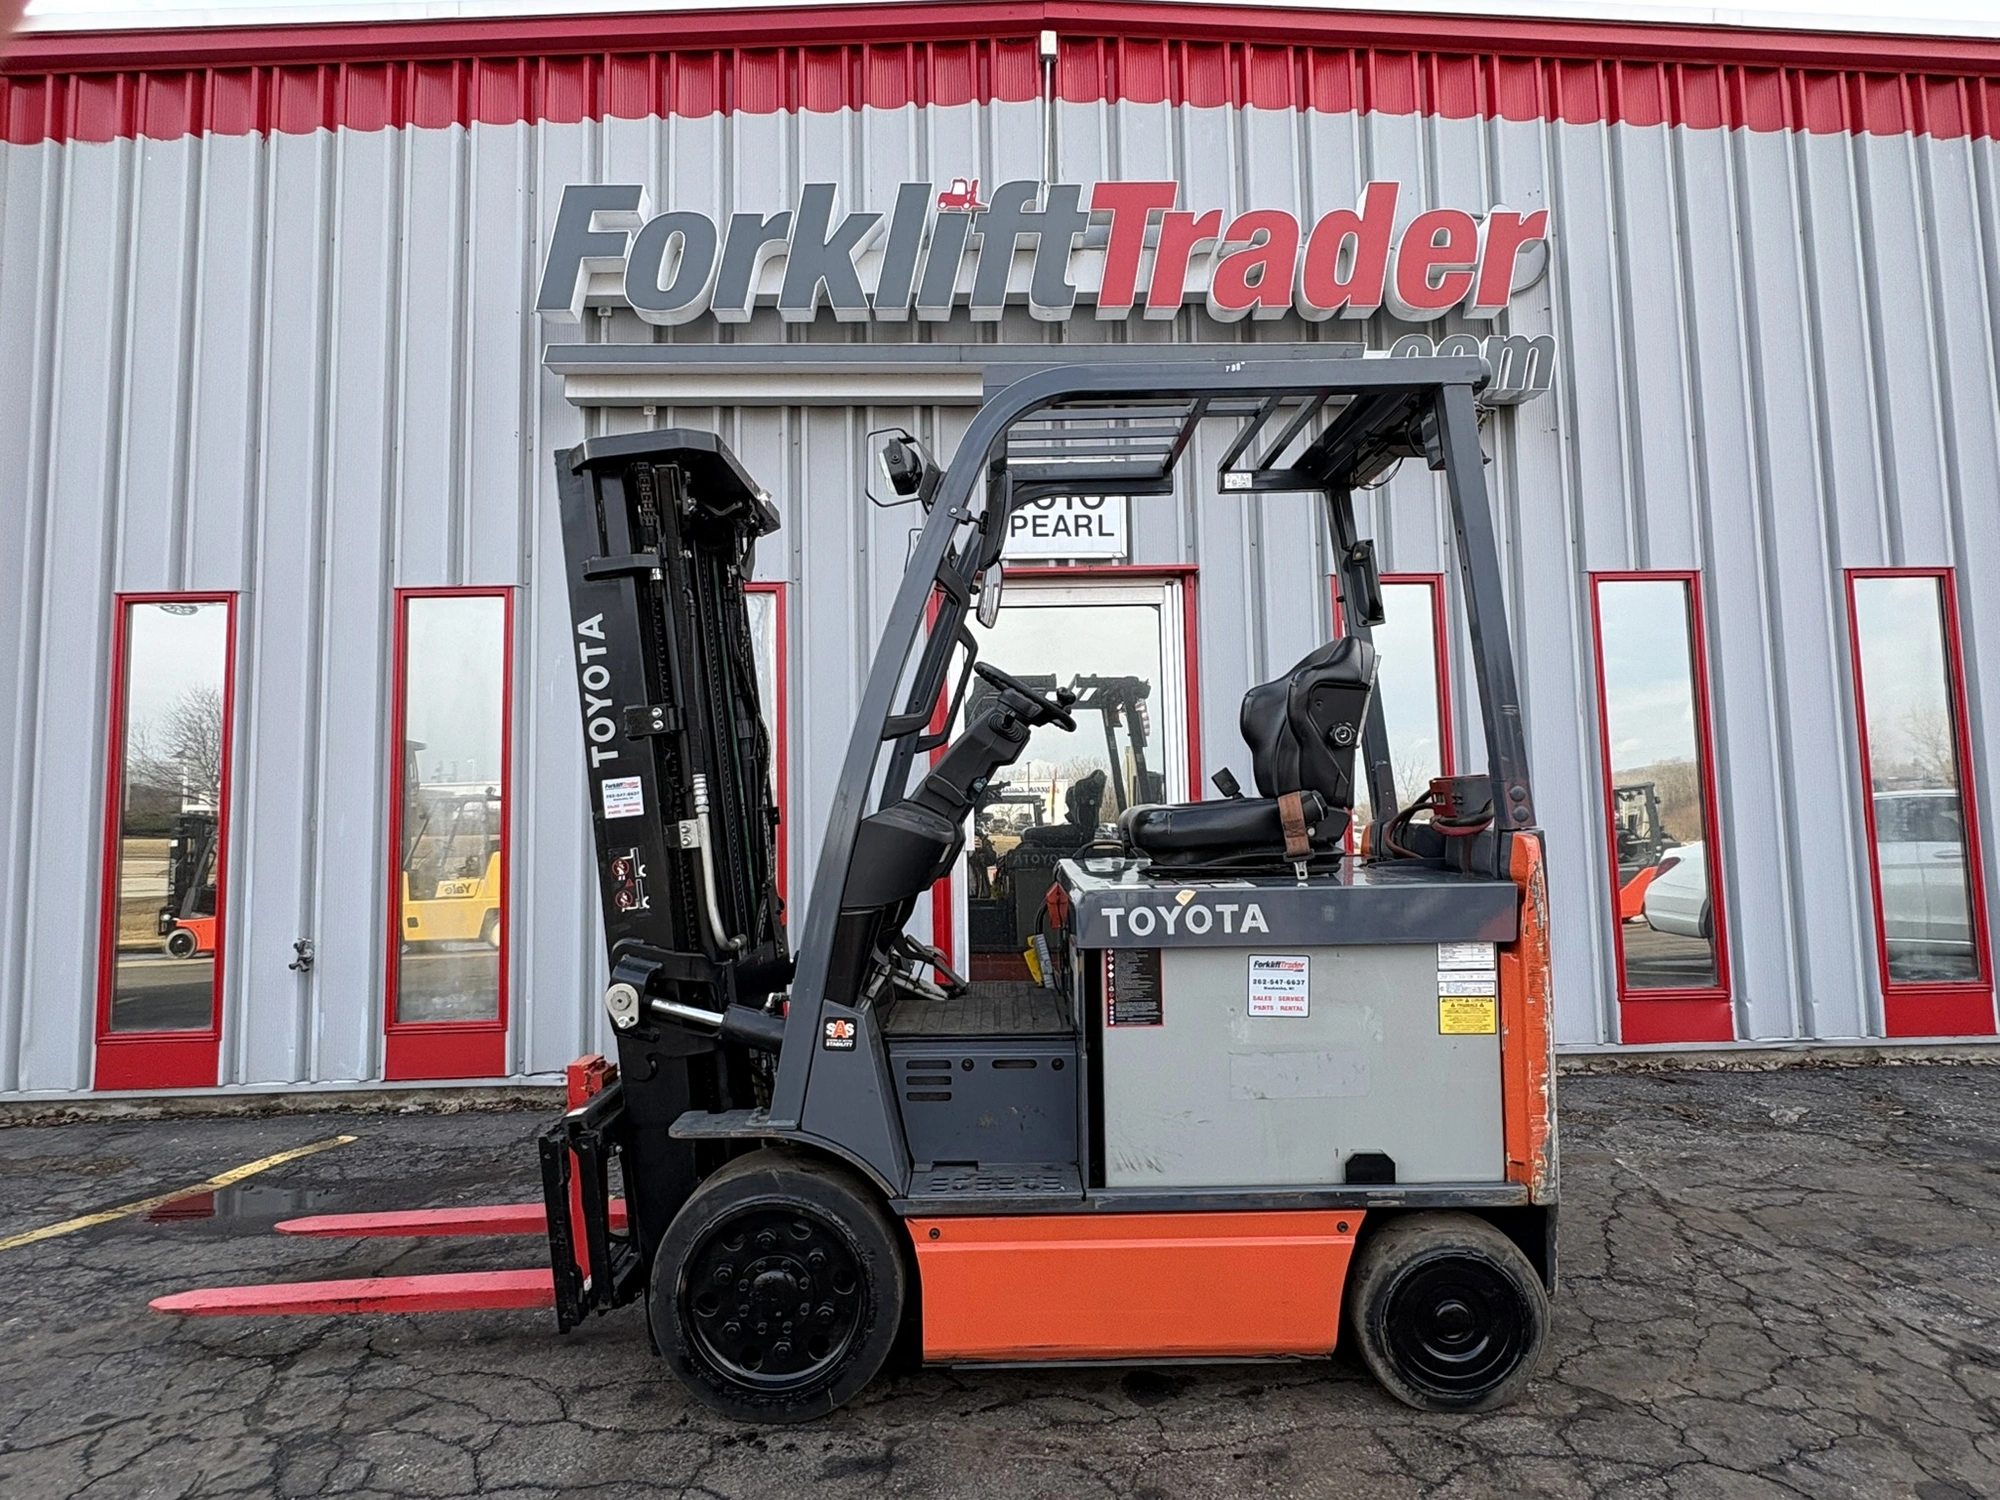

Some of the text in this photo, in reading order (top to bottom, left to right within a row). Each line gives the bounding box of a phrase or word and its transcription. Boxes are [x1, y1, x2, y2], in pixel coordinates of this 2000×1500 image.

[536, 179, 1549, 313] ForkliftTrader
[1010, 514, 1115, 537] PEARL
[577, 613, 619, 768] TOYOTA
[1101, 904, 1270, 937] TOYOTA
[826, 1020, 855, 1038] SAS
